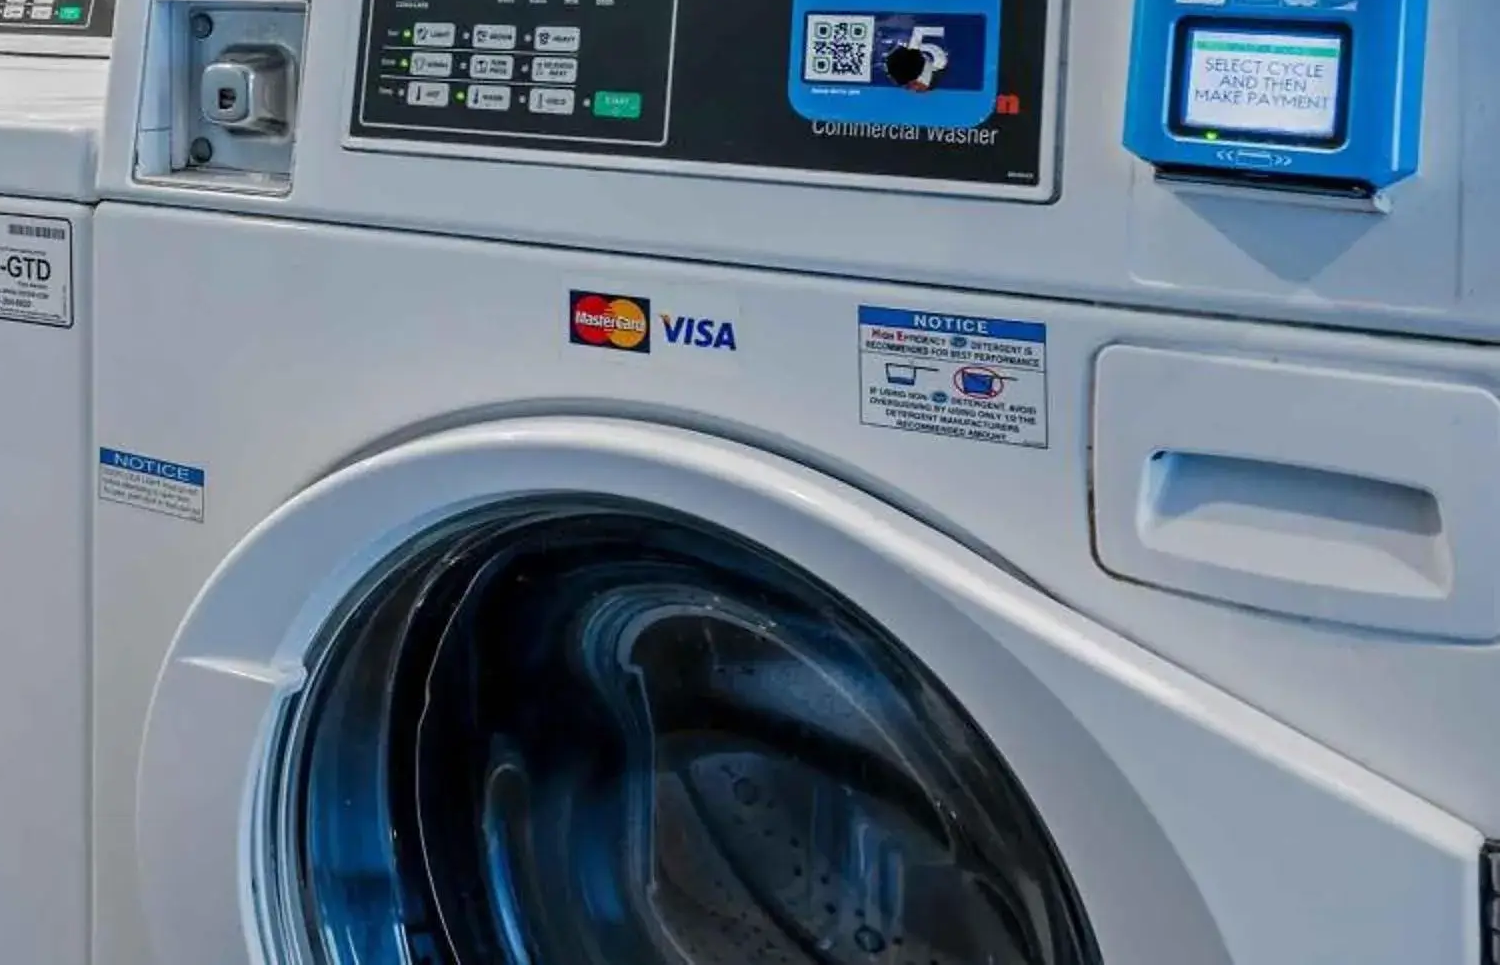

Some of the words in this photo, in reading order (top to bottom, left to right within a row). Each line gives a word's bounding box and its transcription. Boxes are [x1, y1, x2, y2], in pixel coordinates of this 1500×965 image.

[1205, 58, 1263, 74] SELECT
[1267, 61, 1325, 78] CYCLE
[1219, 75, 1258, 90] AND
[1263, 77, 1308, 92] THEN
[1194, 89, 1243, 104] MAKE
[1247, 92, 1330, 110] PAYMENT
[574, 310, 646, 333] MasterCard
[913, 314, 989, 334] NOTICE
[660, 314, 737, 351] VISA
[866, 341, 928, 356] RECOMMENDED
[932, 347, 948, 357] FOR
[971, 341, 1022, 355] DETERGENT
[1024, 345, 1033, 356] IS
[880, 388, 906, 399] USING
[886, 409, 939, 423] DETERGENT
[114, 453, 190, 480] NOTICE
